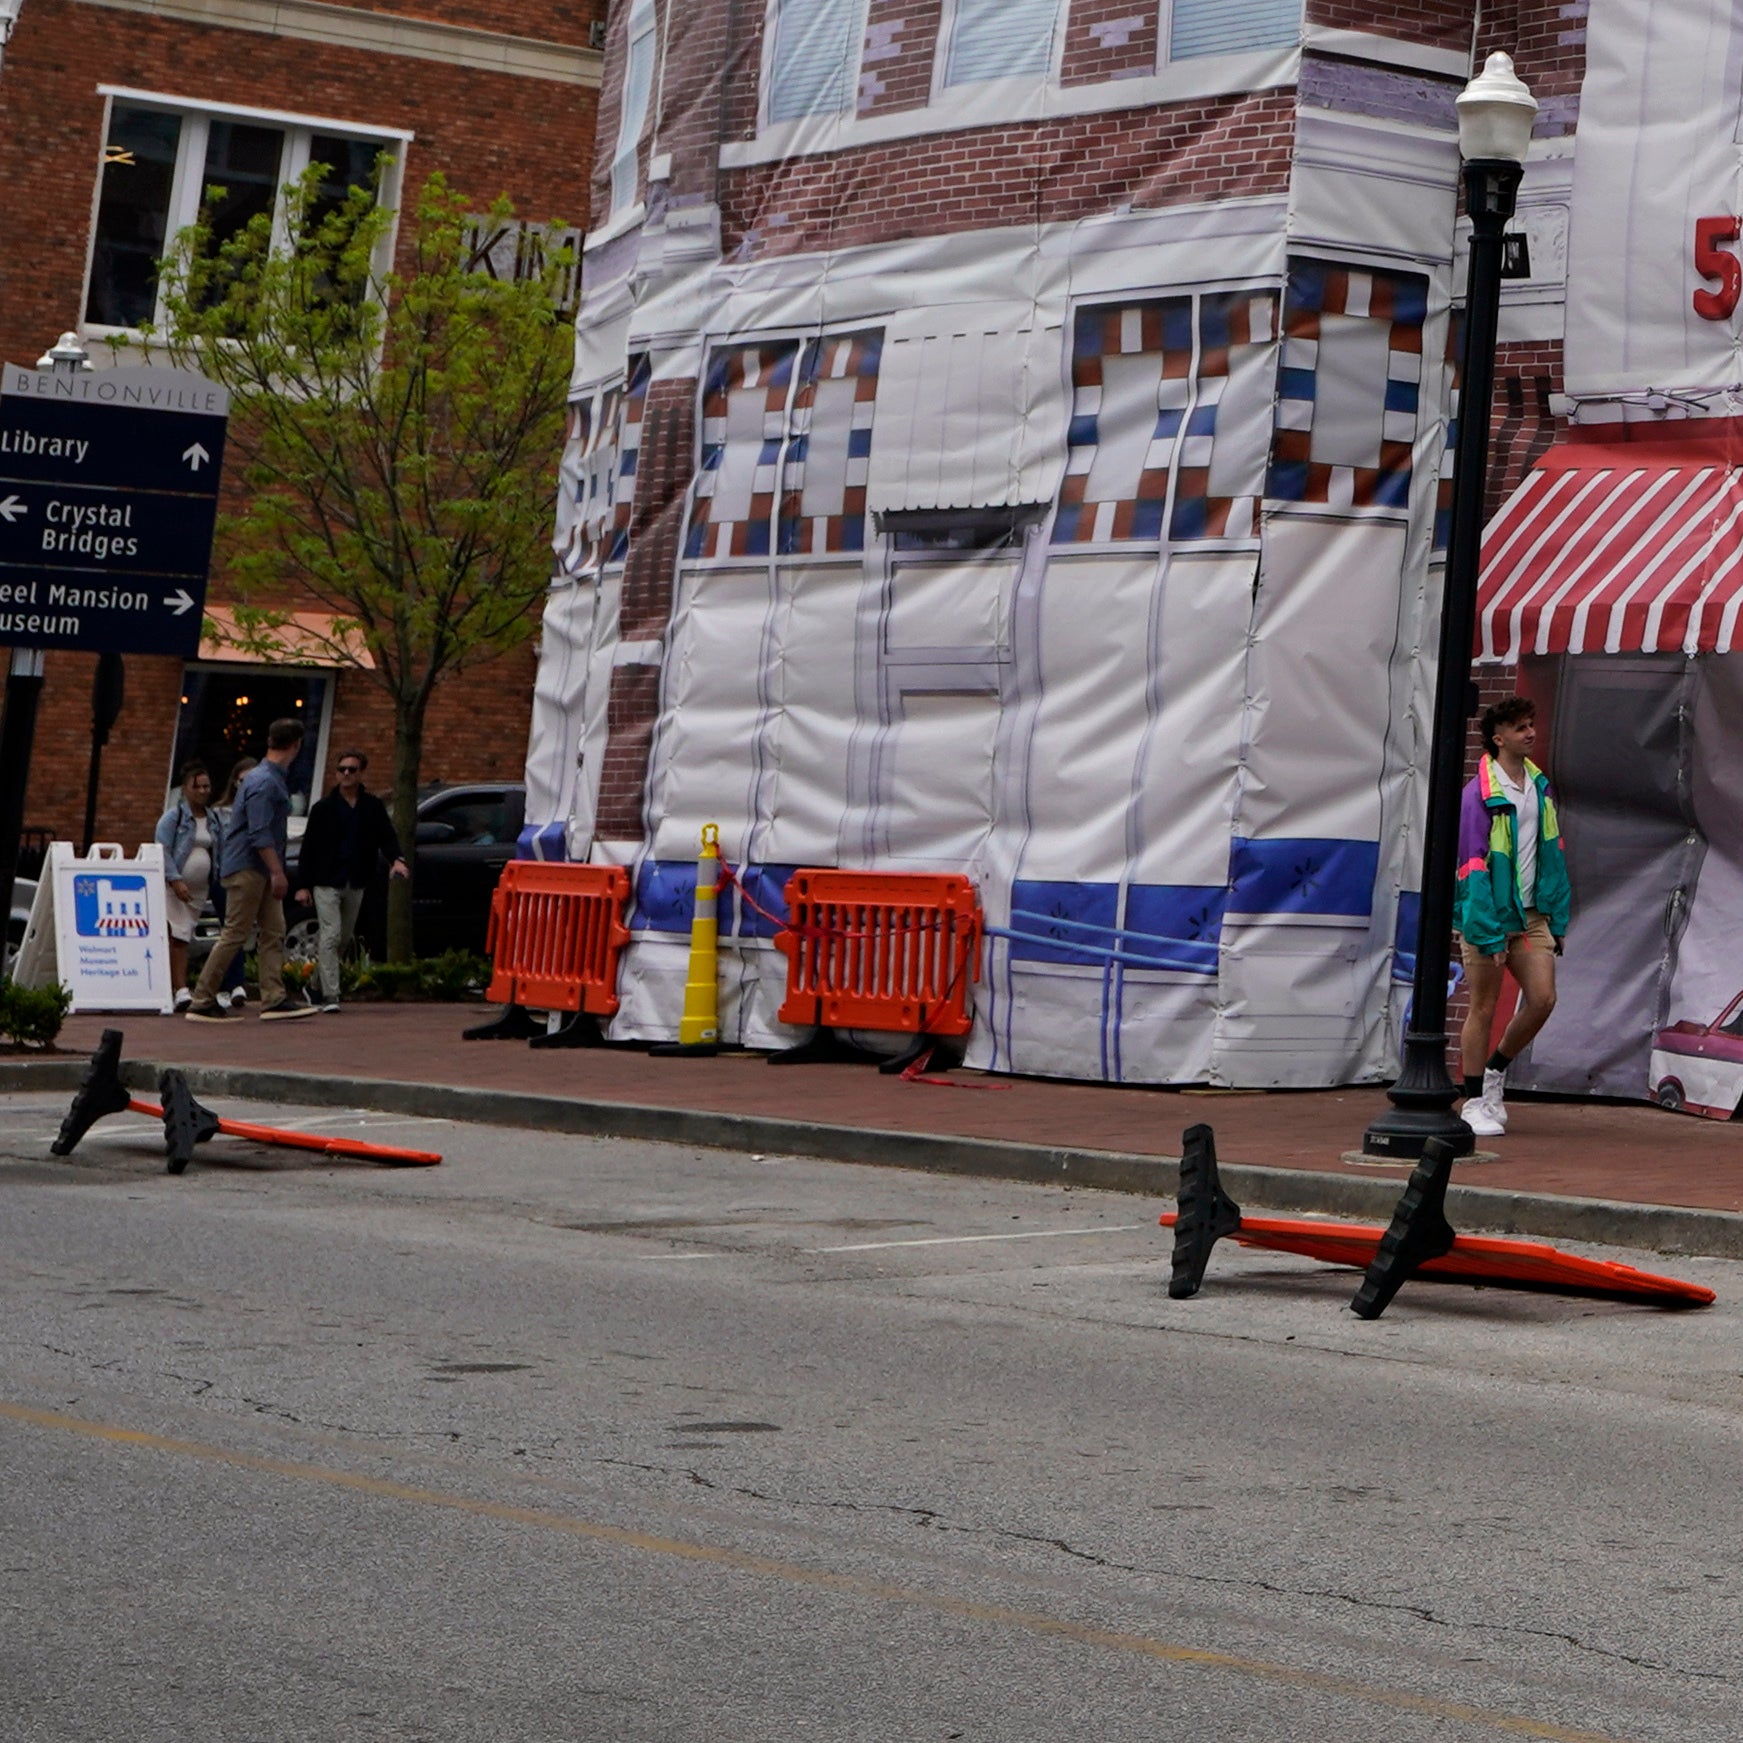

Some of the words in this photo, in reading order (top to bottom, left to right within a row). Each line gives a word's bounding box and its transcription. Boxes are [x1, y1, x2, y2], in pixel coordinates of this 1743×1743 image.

[16, 373, 217, 412] BENTONVILLE
[1, 430, 89, 464] Library
[46, 500, 132, 530] Crystal
[41, 528, 138, 559] Bridges
[0, 581, 37, 605] eel
[48, 583, 149, 611] Mansion
[0, 612, 80, 635] useum
